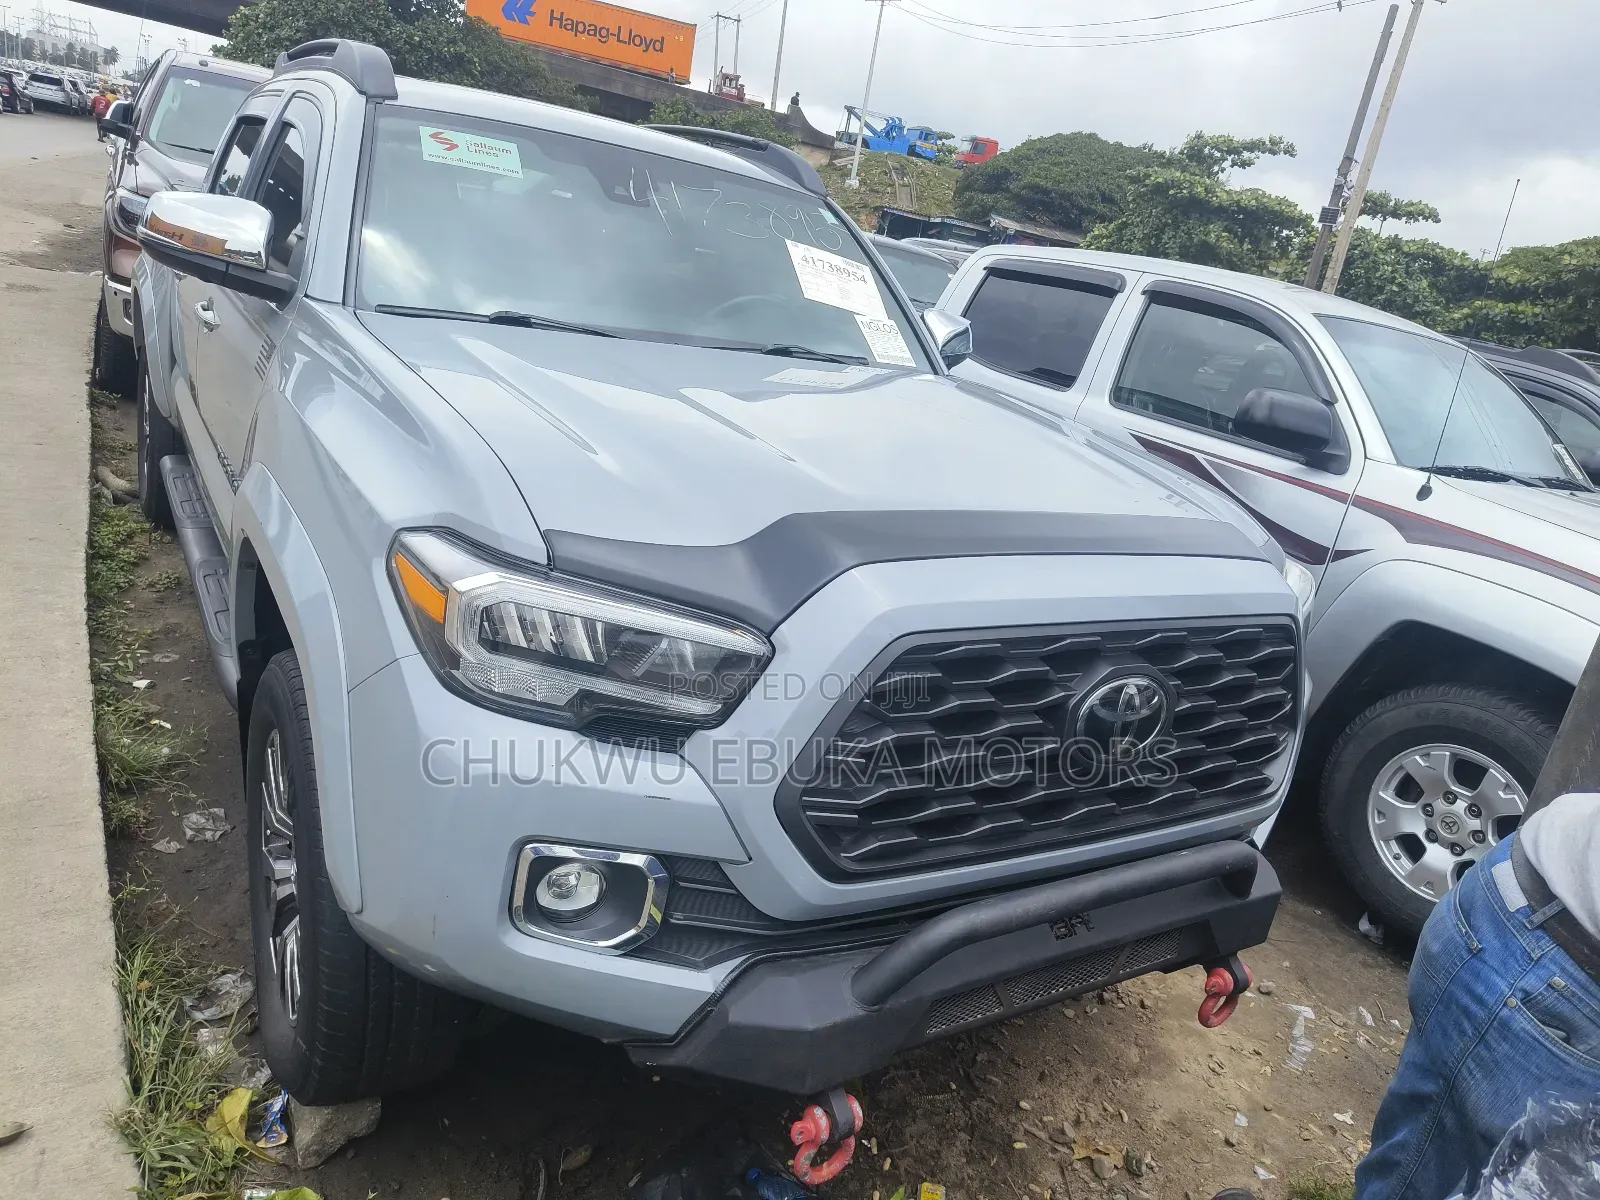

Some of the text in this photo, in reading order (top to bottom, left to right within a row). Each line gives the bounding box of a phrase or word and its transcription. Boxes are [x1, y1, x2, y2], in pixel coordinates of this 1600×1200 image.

[549, 9, 665, 53] Hapag-Lloyd
[466, 140, 512, 155] Sallaum
[467, 146, 499, 158] Lines
[801, 254, 868, 285] 41738954
[861, 320, 899, 335] NGLOS
